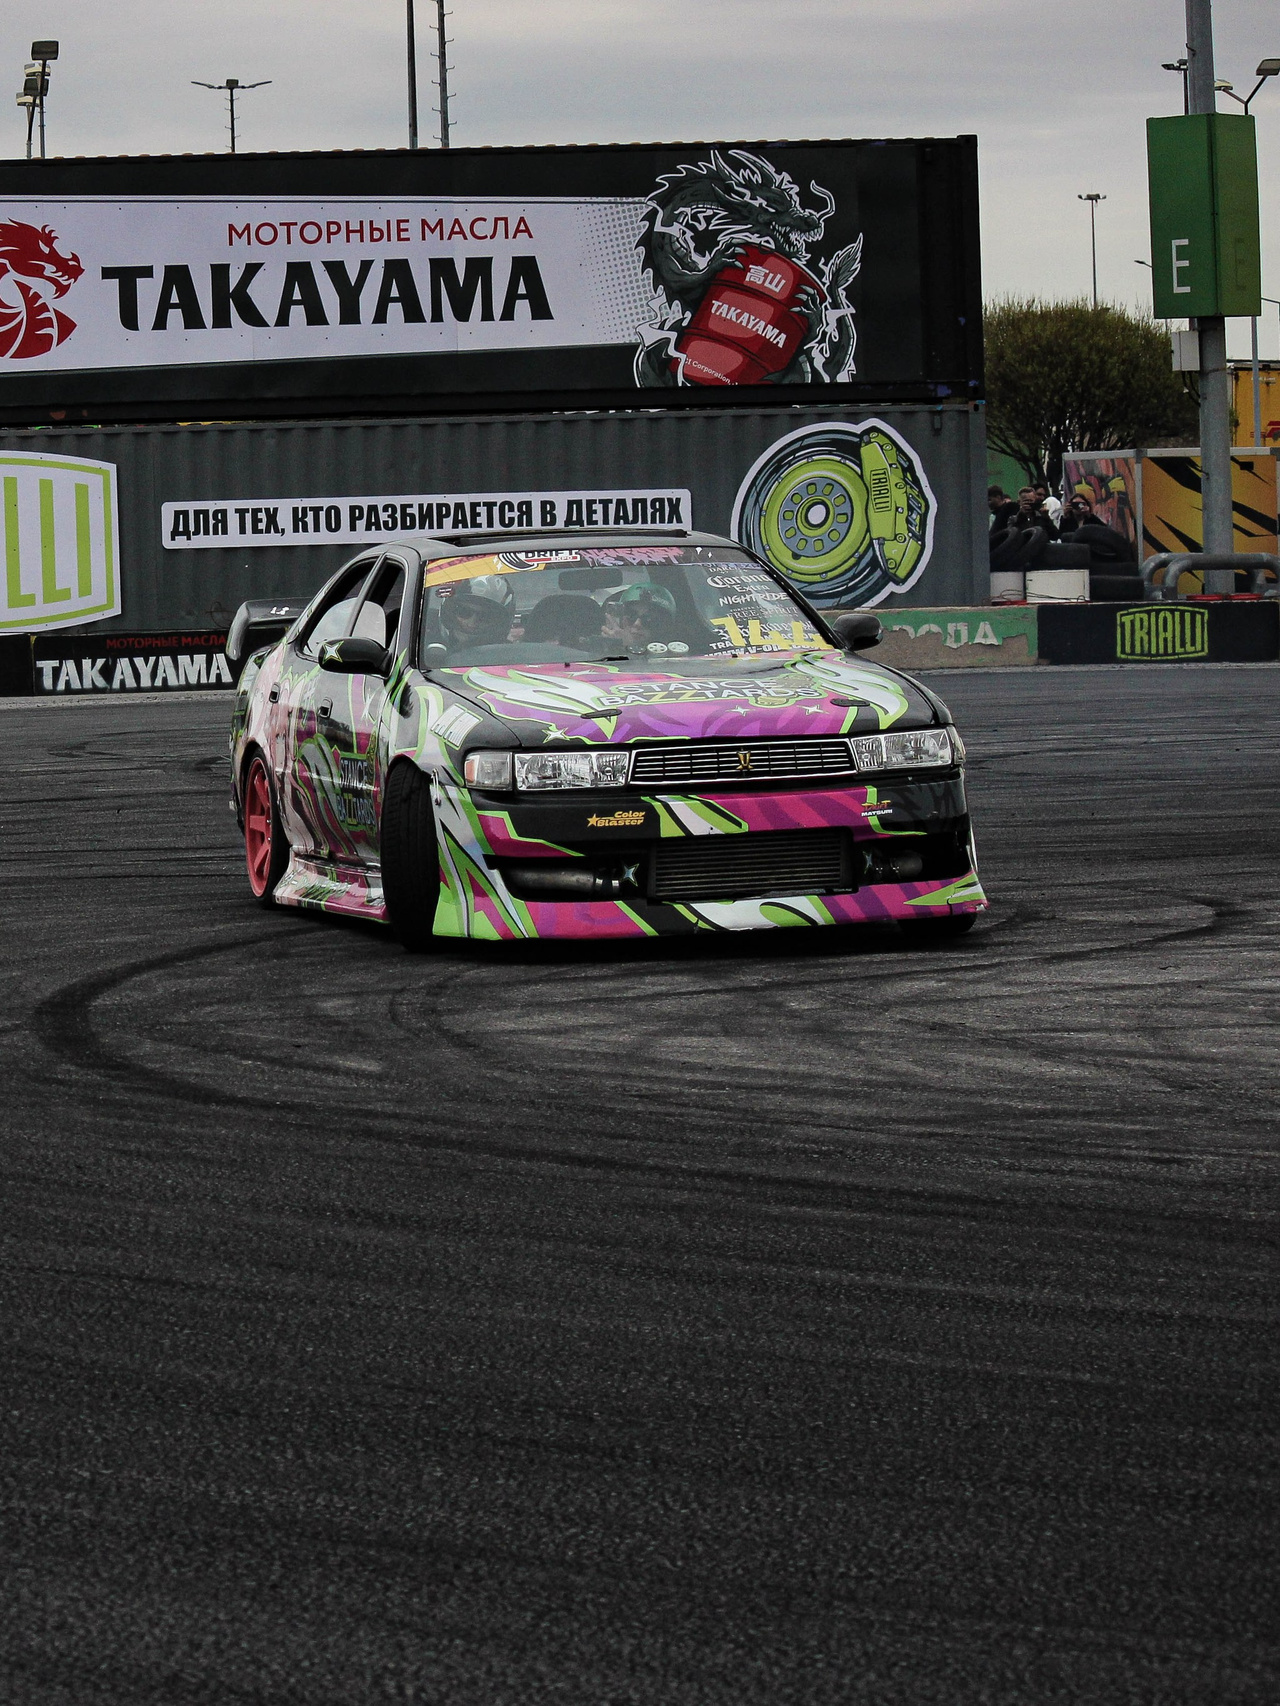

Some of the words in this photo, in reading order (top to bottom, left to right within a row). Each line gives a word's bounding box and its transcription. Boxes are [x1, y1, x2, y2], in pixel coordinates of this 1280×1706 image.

[227, 218, 411, 247] МОТОРНЫЕ
[420, 216, 535, 242] МАСЛА
[745, 264, 787, 293] 高山
[1171, 238, 1191, 293] E
[101, 255, 555, 332] TAKAYAMA
[711, 299, 788, 349] TAKAYAMA
[872, 470, 890, 510] TRIALLI
[170, 508, 228, 541] ДЛЯ
[234, 506, 286, 536] ТЕХ,
[292, 504, 342, 533] КТО
[349, 500, 533, 532] РАЗБИРАЕТСЯ
[540, 499, 557, 527] В
[564, 497, 683, 528] ДЕТАЛЯХ
[707, 574, 773, 589] Corona
[732, 584, 770, 593] Extra
[106, 636, 178, 649] МОТОРНЫЕ
[181, 634, 227, 646] МАСЛА
[1121, 610, 1202, 654] TRIALLI
[36, 653, 233, 691] TAKAYAMA
[618, 679, 778, 694] STANCE
[600, 688, 822, 706] BAZZTARDS
[597, 819, 644, 827] Blaster
[614, 810, 646, 818] Color
